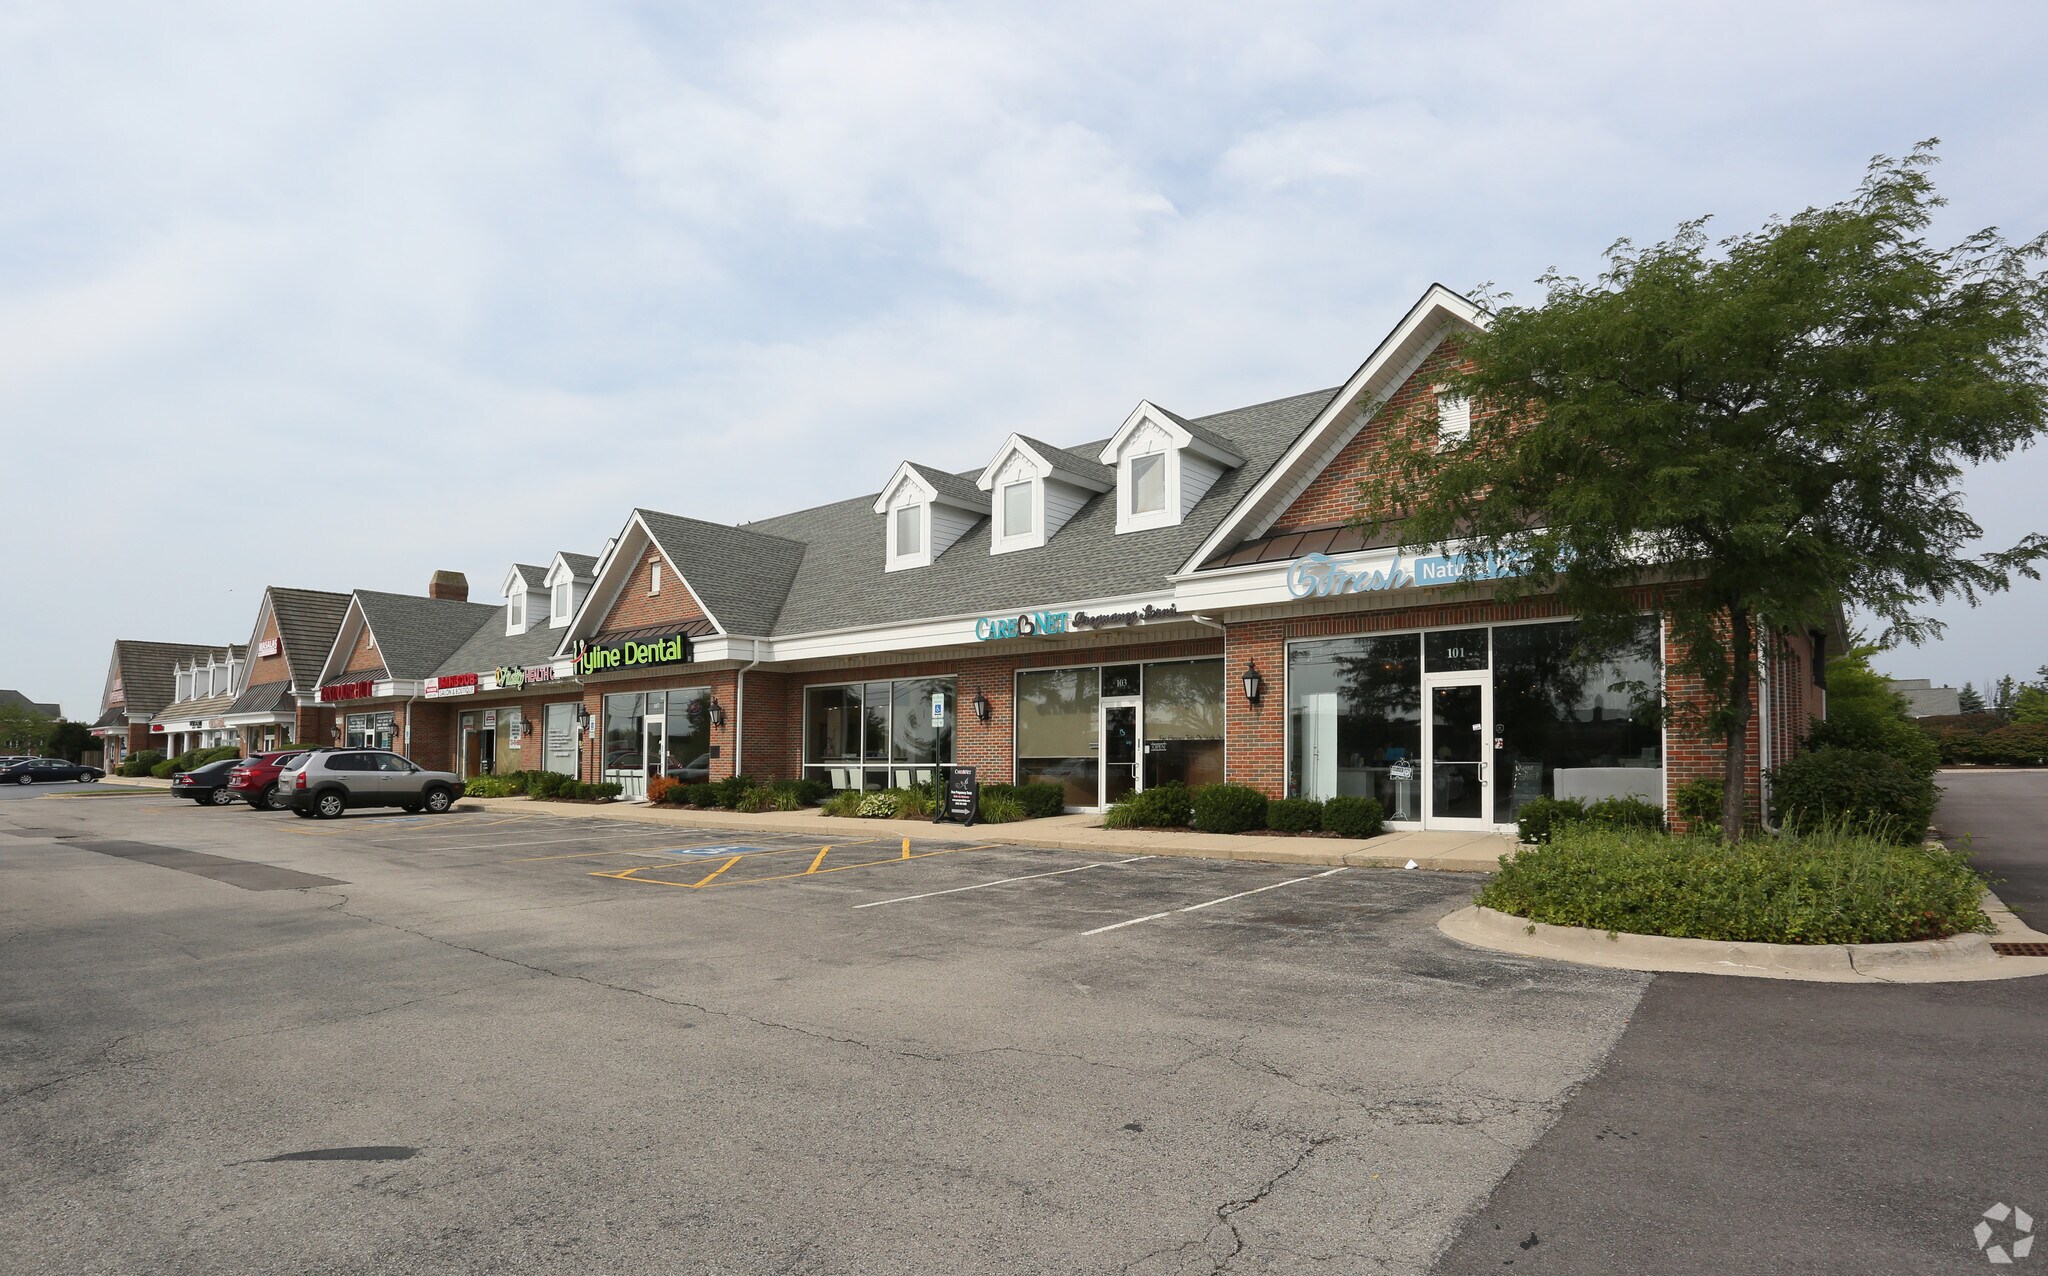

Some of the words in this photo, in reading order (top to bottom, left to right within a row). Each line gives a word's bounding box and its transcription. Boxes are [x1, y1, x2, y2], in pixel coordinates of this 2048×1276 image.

[1139, 604, 1177, 620] Servi
[571, 640, 620, 675] Hyline
[624, 635, 681, 665] Dental
[1447, 648, 1465, 659] 101
[525, 667, 549, 683] HEALTH
[1116, 679, 1128, 688] 103
